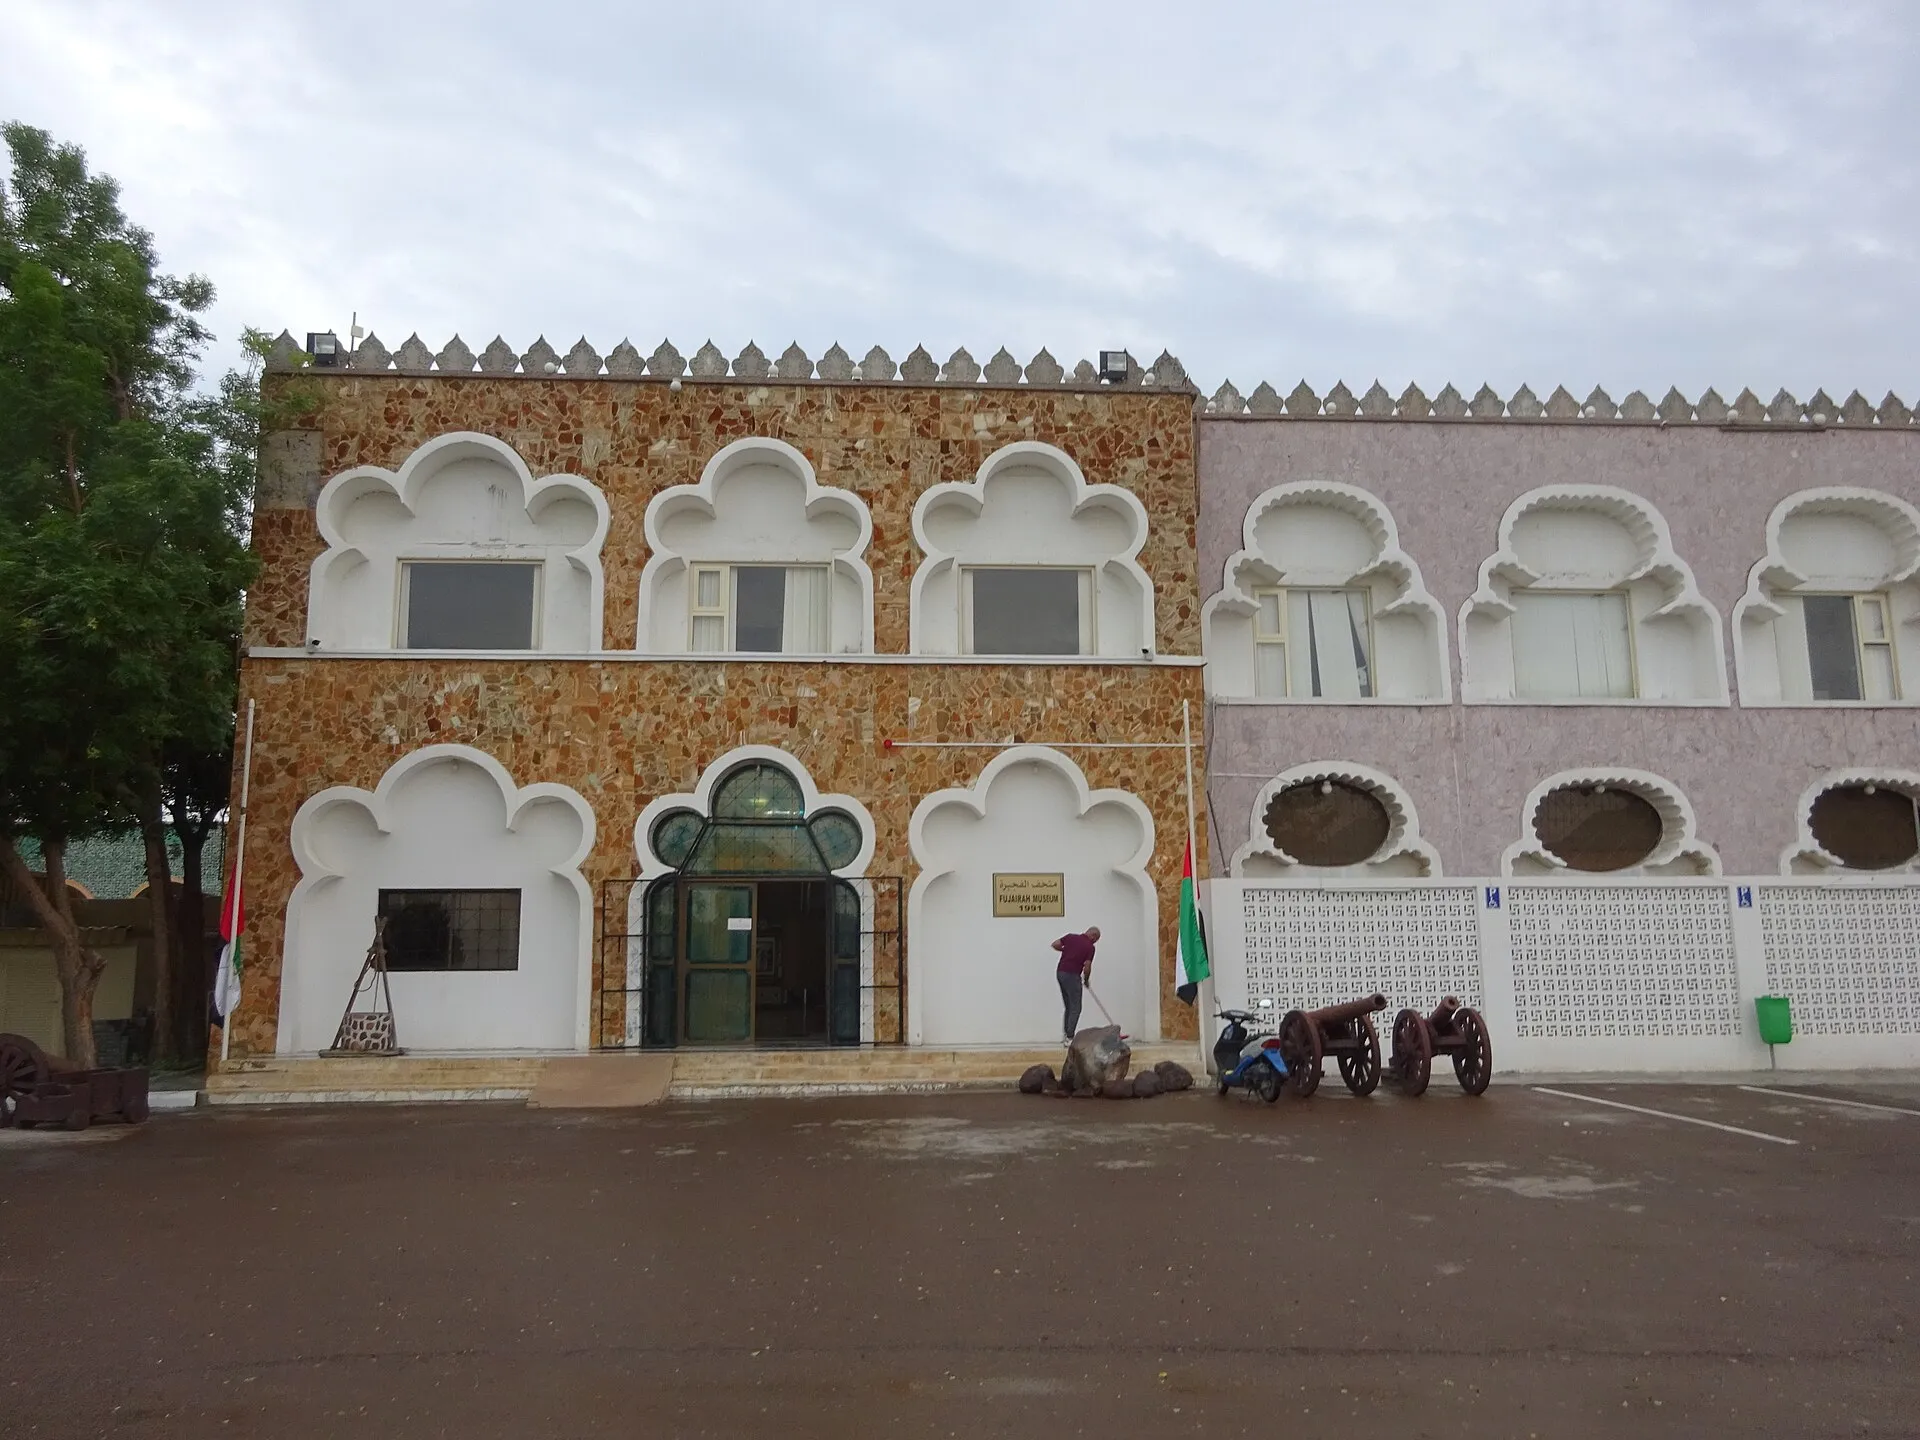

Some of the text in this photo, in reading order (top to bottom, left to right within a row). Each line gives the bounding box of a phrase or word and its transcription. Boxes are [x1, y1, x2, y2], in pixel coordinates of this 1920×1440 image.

[1000, 880, 1058, 891] متحف الفجيرة
[1000, 894, 1059, 903] FUJAIRAH MUSEUM
